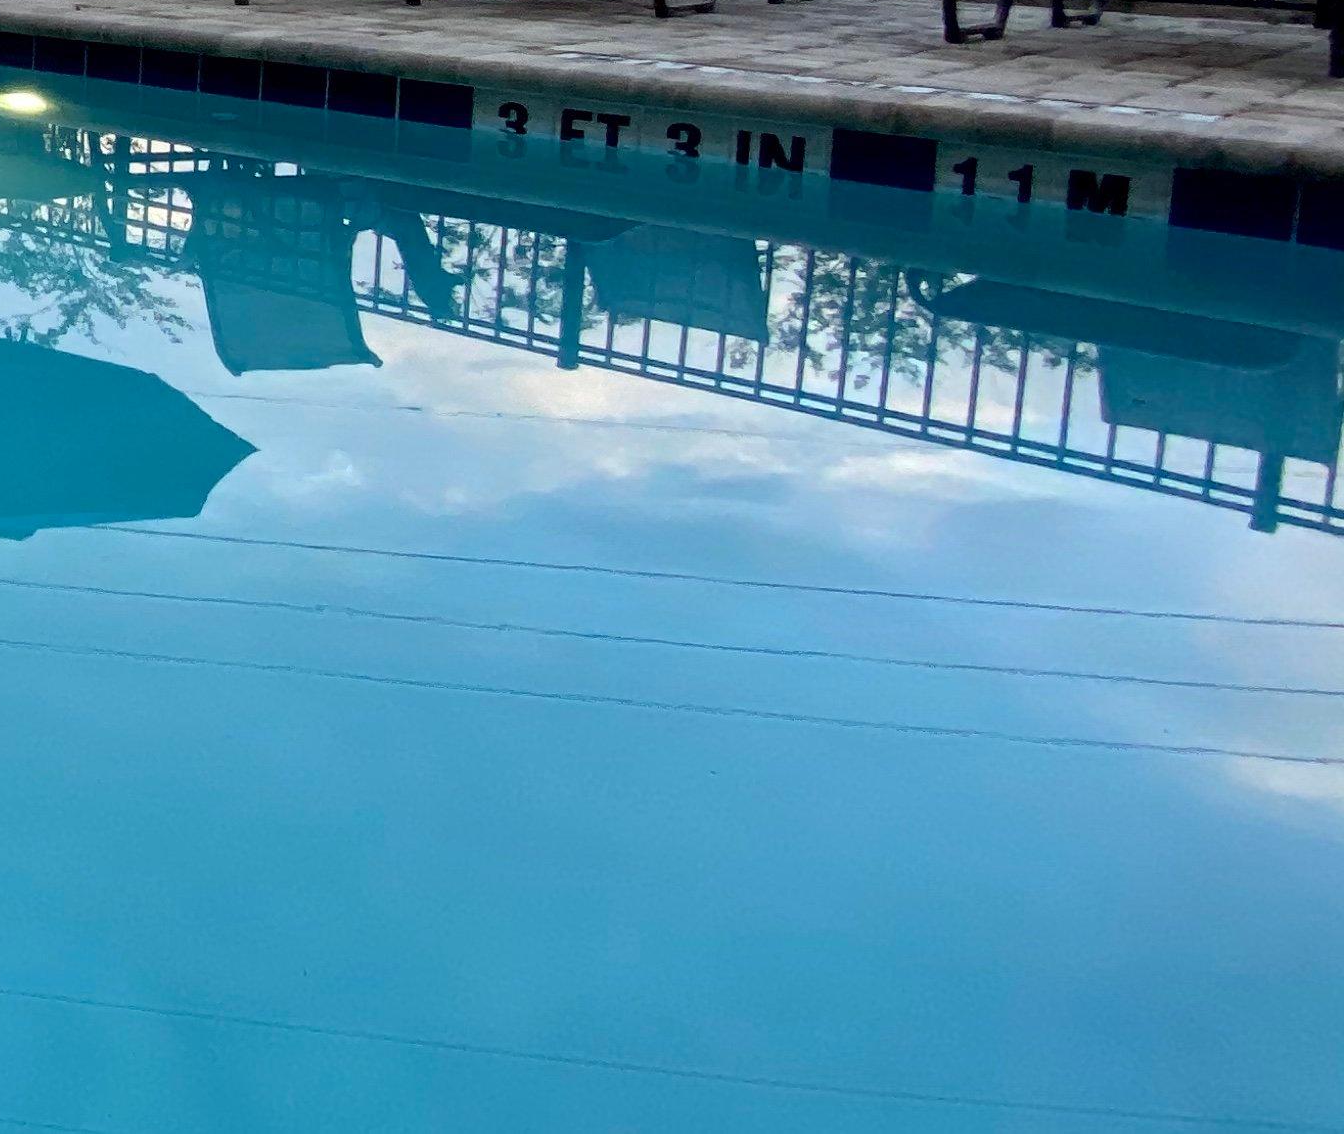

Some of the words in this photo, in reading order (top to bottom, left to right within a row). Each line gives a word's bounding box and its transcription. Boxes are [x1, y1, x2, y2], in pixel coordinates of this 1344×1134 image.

[498, 102, 529, 134] 3
[560, 109, 631, 147] FT
[667, 123, 702, 157] 3
[736, 130, 807, 172] IN
[1067, 169, 1132, 217] M
